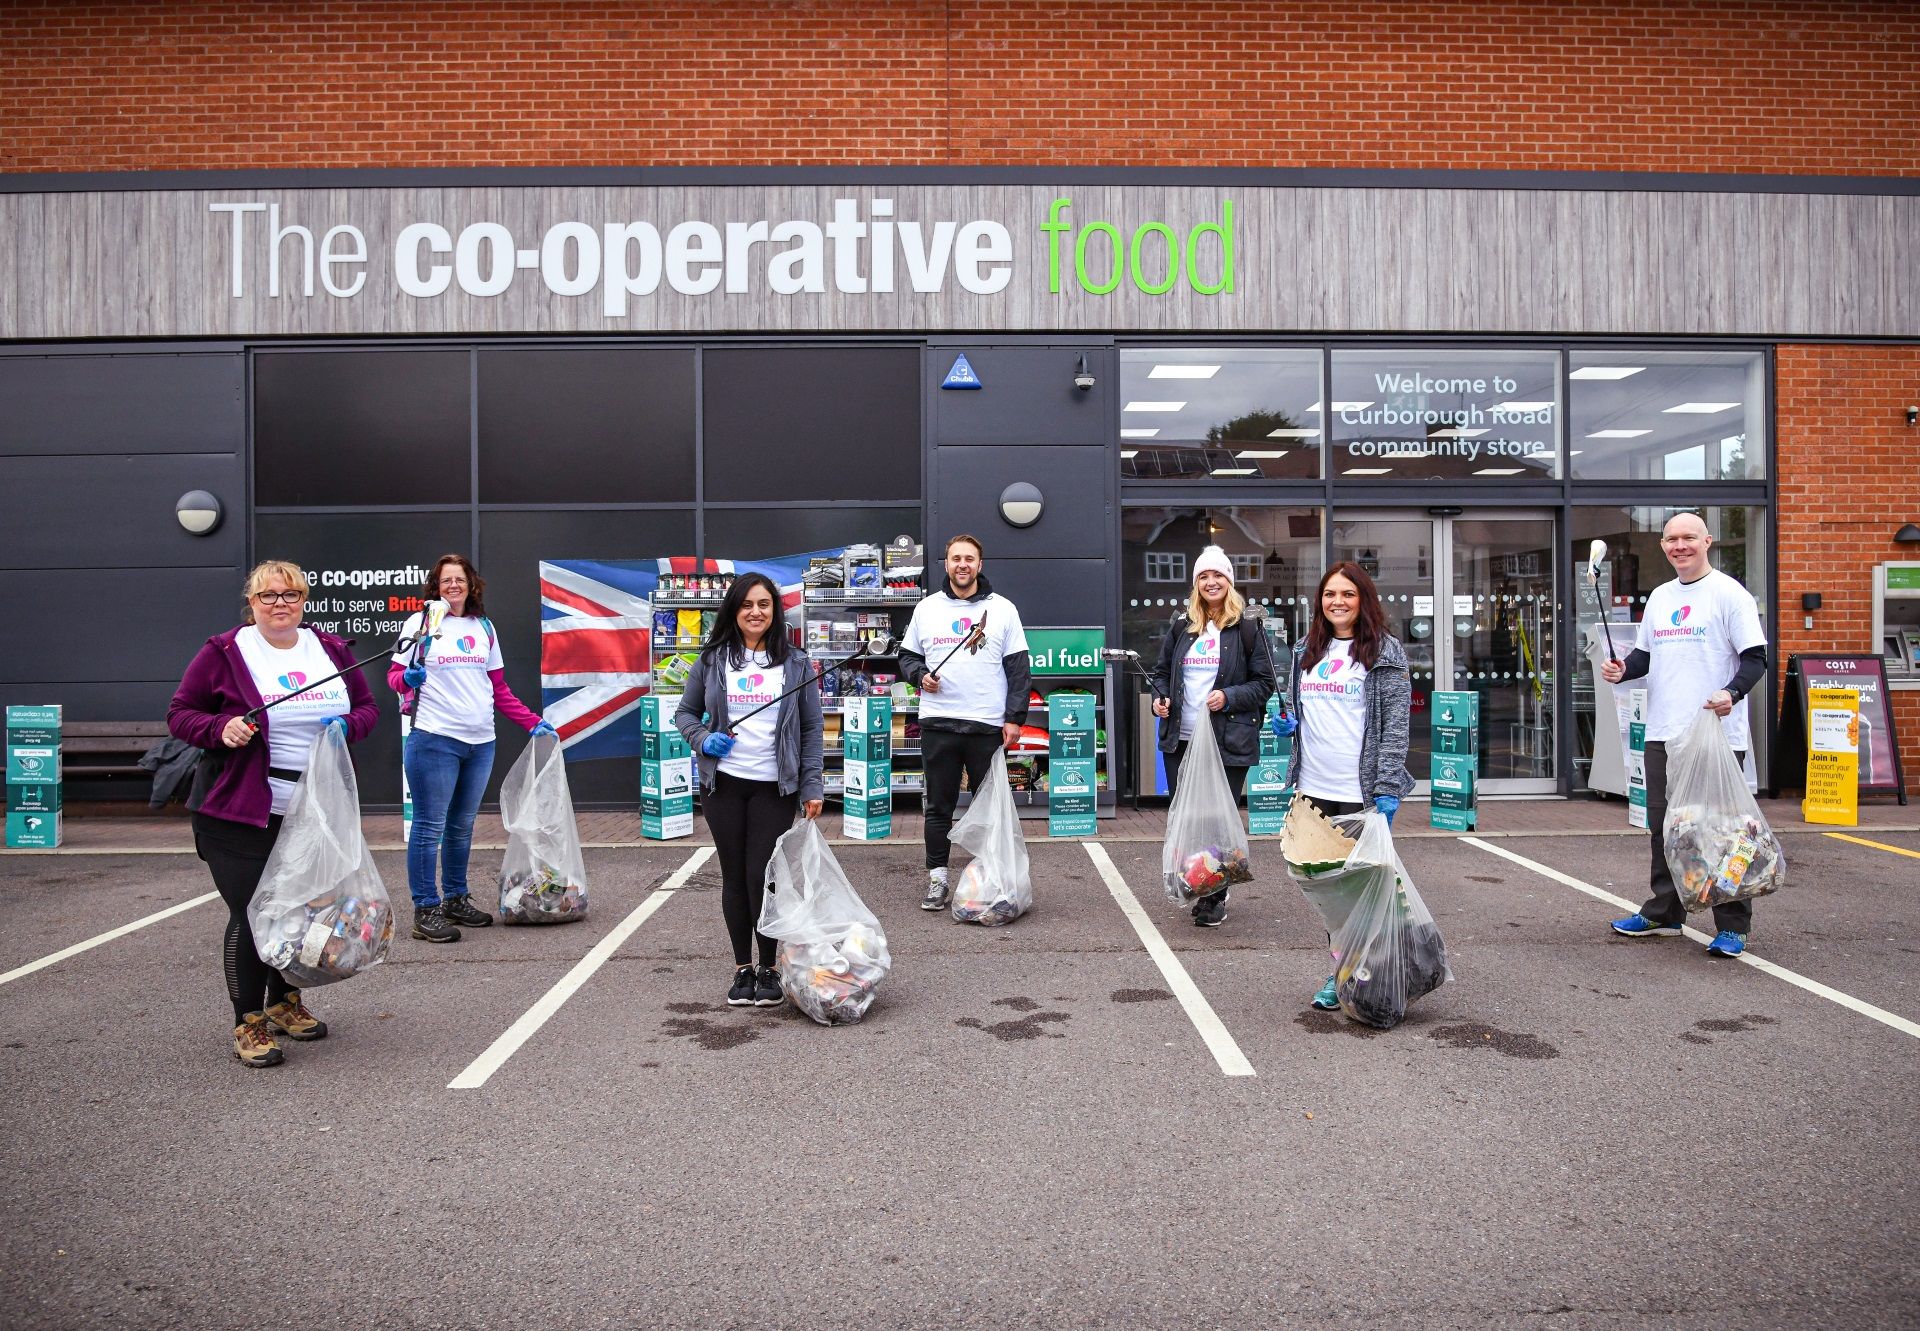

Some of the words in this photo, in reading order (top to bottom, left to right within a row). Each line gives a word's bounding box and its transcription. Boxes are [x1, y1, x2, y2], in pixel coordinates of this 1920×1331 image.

[209, 203, 367, 297] The
[394, 199, 1013, 316] co-operative
[1040, 198, 1234, 295] food
[1375, 372, 1486, 394] Welcome
[1493, 375, 1517, 394] to
[1340, 404, 1484, 430] Curborough
[1493, 404, 1552, 424] Road
[1348, 436, 1481, 462] community
[1487, 438, 1546, 456] store
[322, 565, 430, 590] co-operativ
[304, 598, 328, 612] oud
[333, 599, 345, 612] to
[349, 600, 384, 612] serve
[388, 596, 425, 612] Brita
[345, 618, 370, 633] 165
[375, 621, 404, 636] year
[1059, 648, 1098, 667] fuel
[1181, 656, 1220, 665] ementia
[1826, 662, 1856, 670] COSTA
[1845, 682, 1876, 691] ground
[262, 690, 342, 702] ementiaUK
[1810, 772, 1844, 780] community
